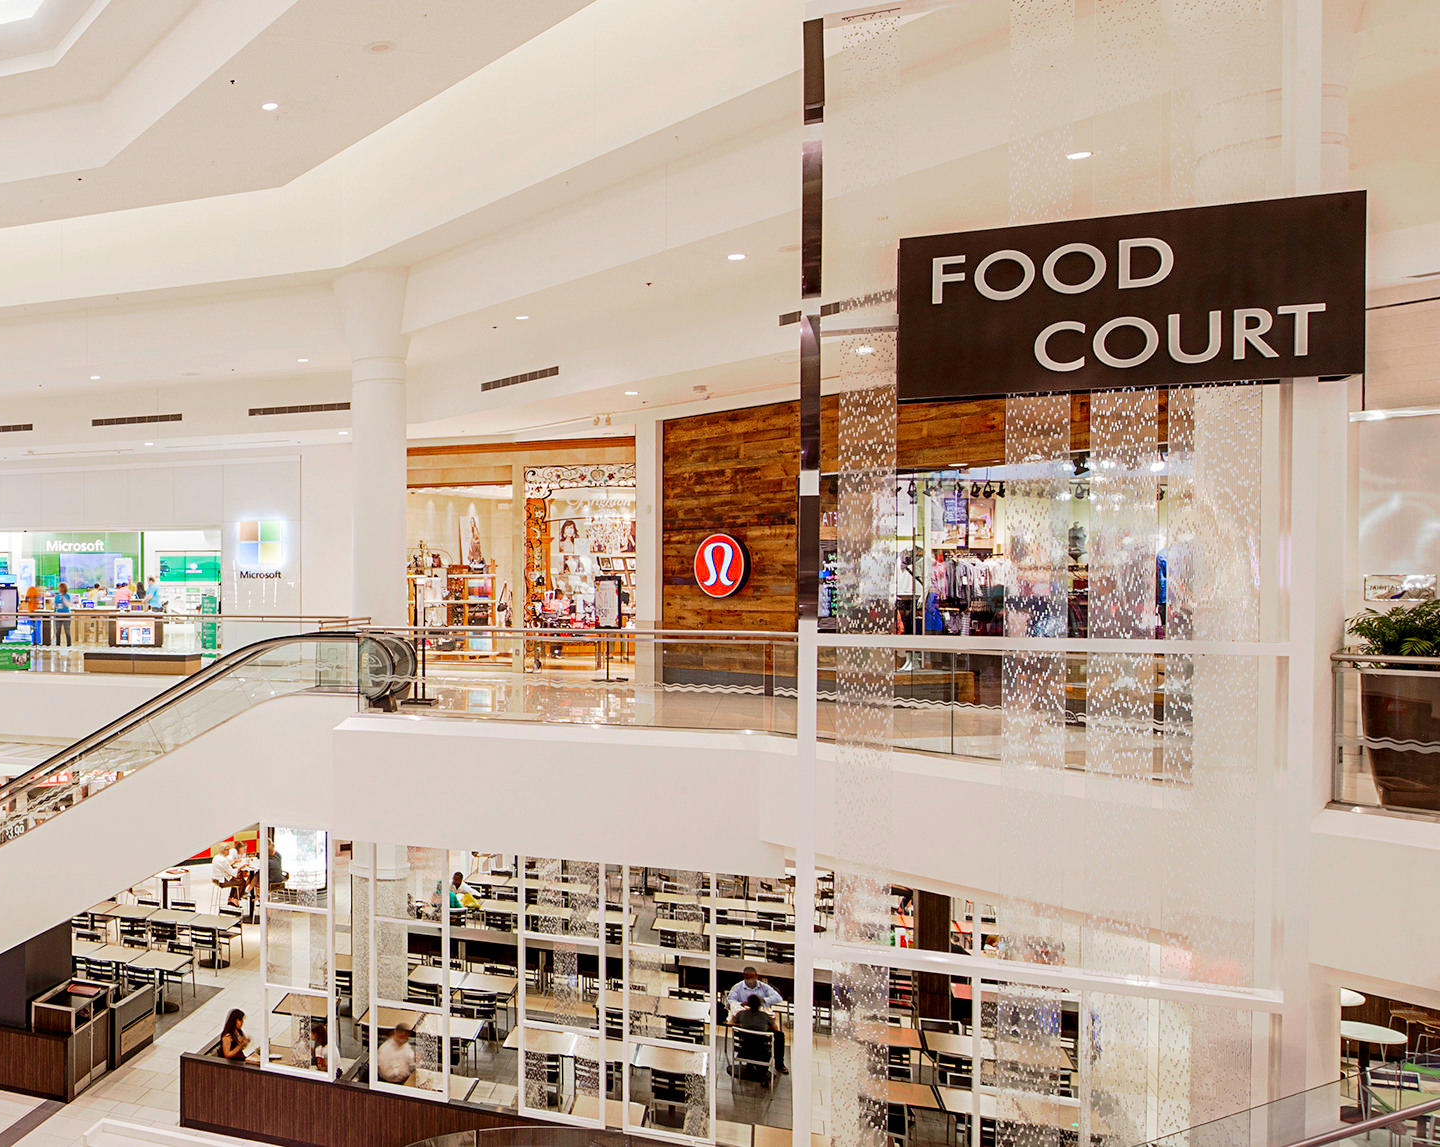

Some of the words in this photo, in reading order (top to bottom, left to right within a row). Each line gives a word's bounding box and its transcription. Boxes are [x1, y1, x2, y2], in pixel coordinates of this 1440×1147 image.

[931, 237, 1174, 305] FOOD
[1033, 302, 1326, 372] COURT
[46, 540, 105, 552] Microsoft
[240, 571, 282, 579] Microsoft
